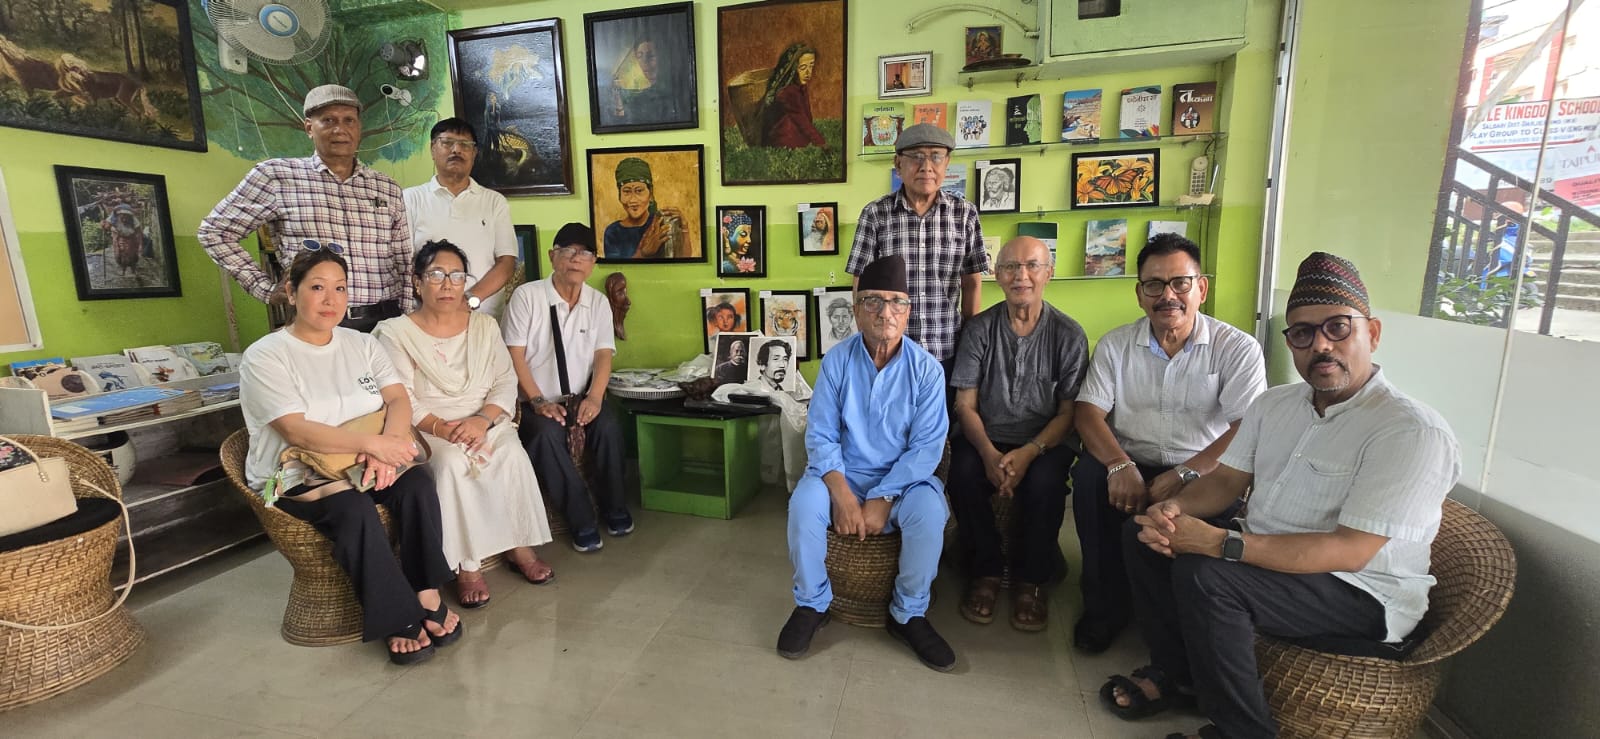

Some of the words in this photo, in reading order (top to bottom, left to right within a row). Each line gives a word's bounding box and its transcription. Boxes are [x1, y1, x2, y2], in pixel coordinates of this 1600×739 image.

[1505, 104, 1550, 120] KINGDO
[1489, 129, 1518, 138] GROUP
[1533, 127, 1559, 135] CLSS
